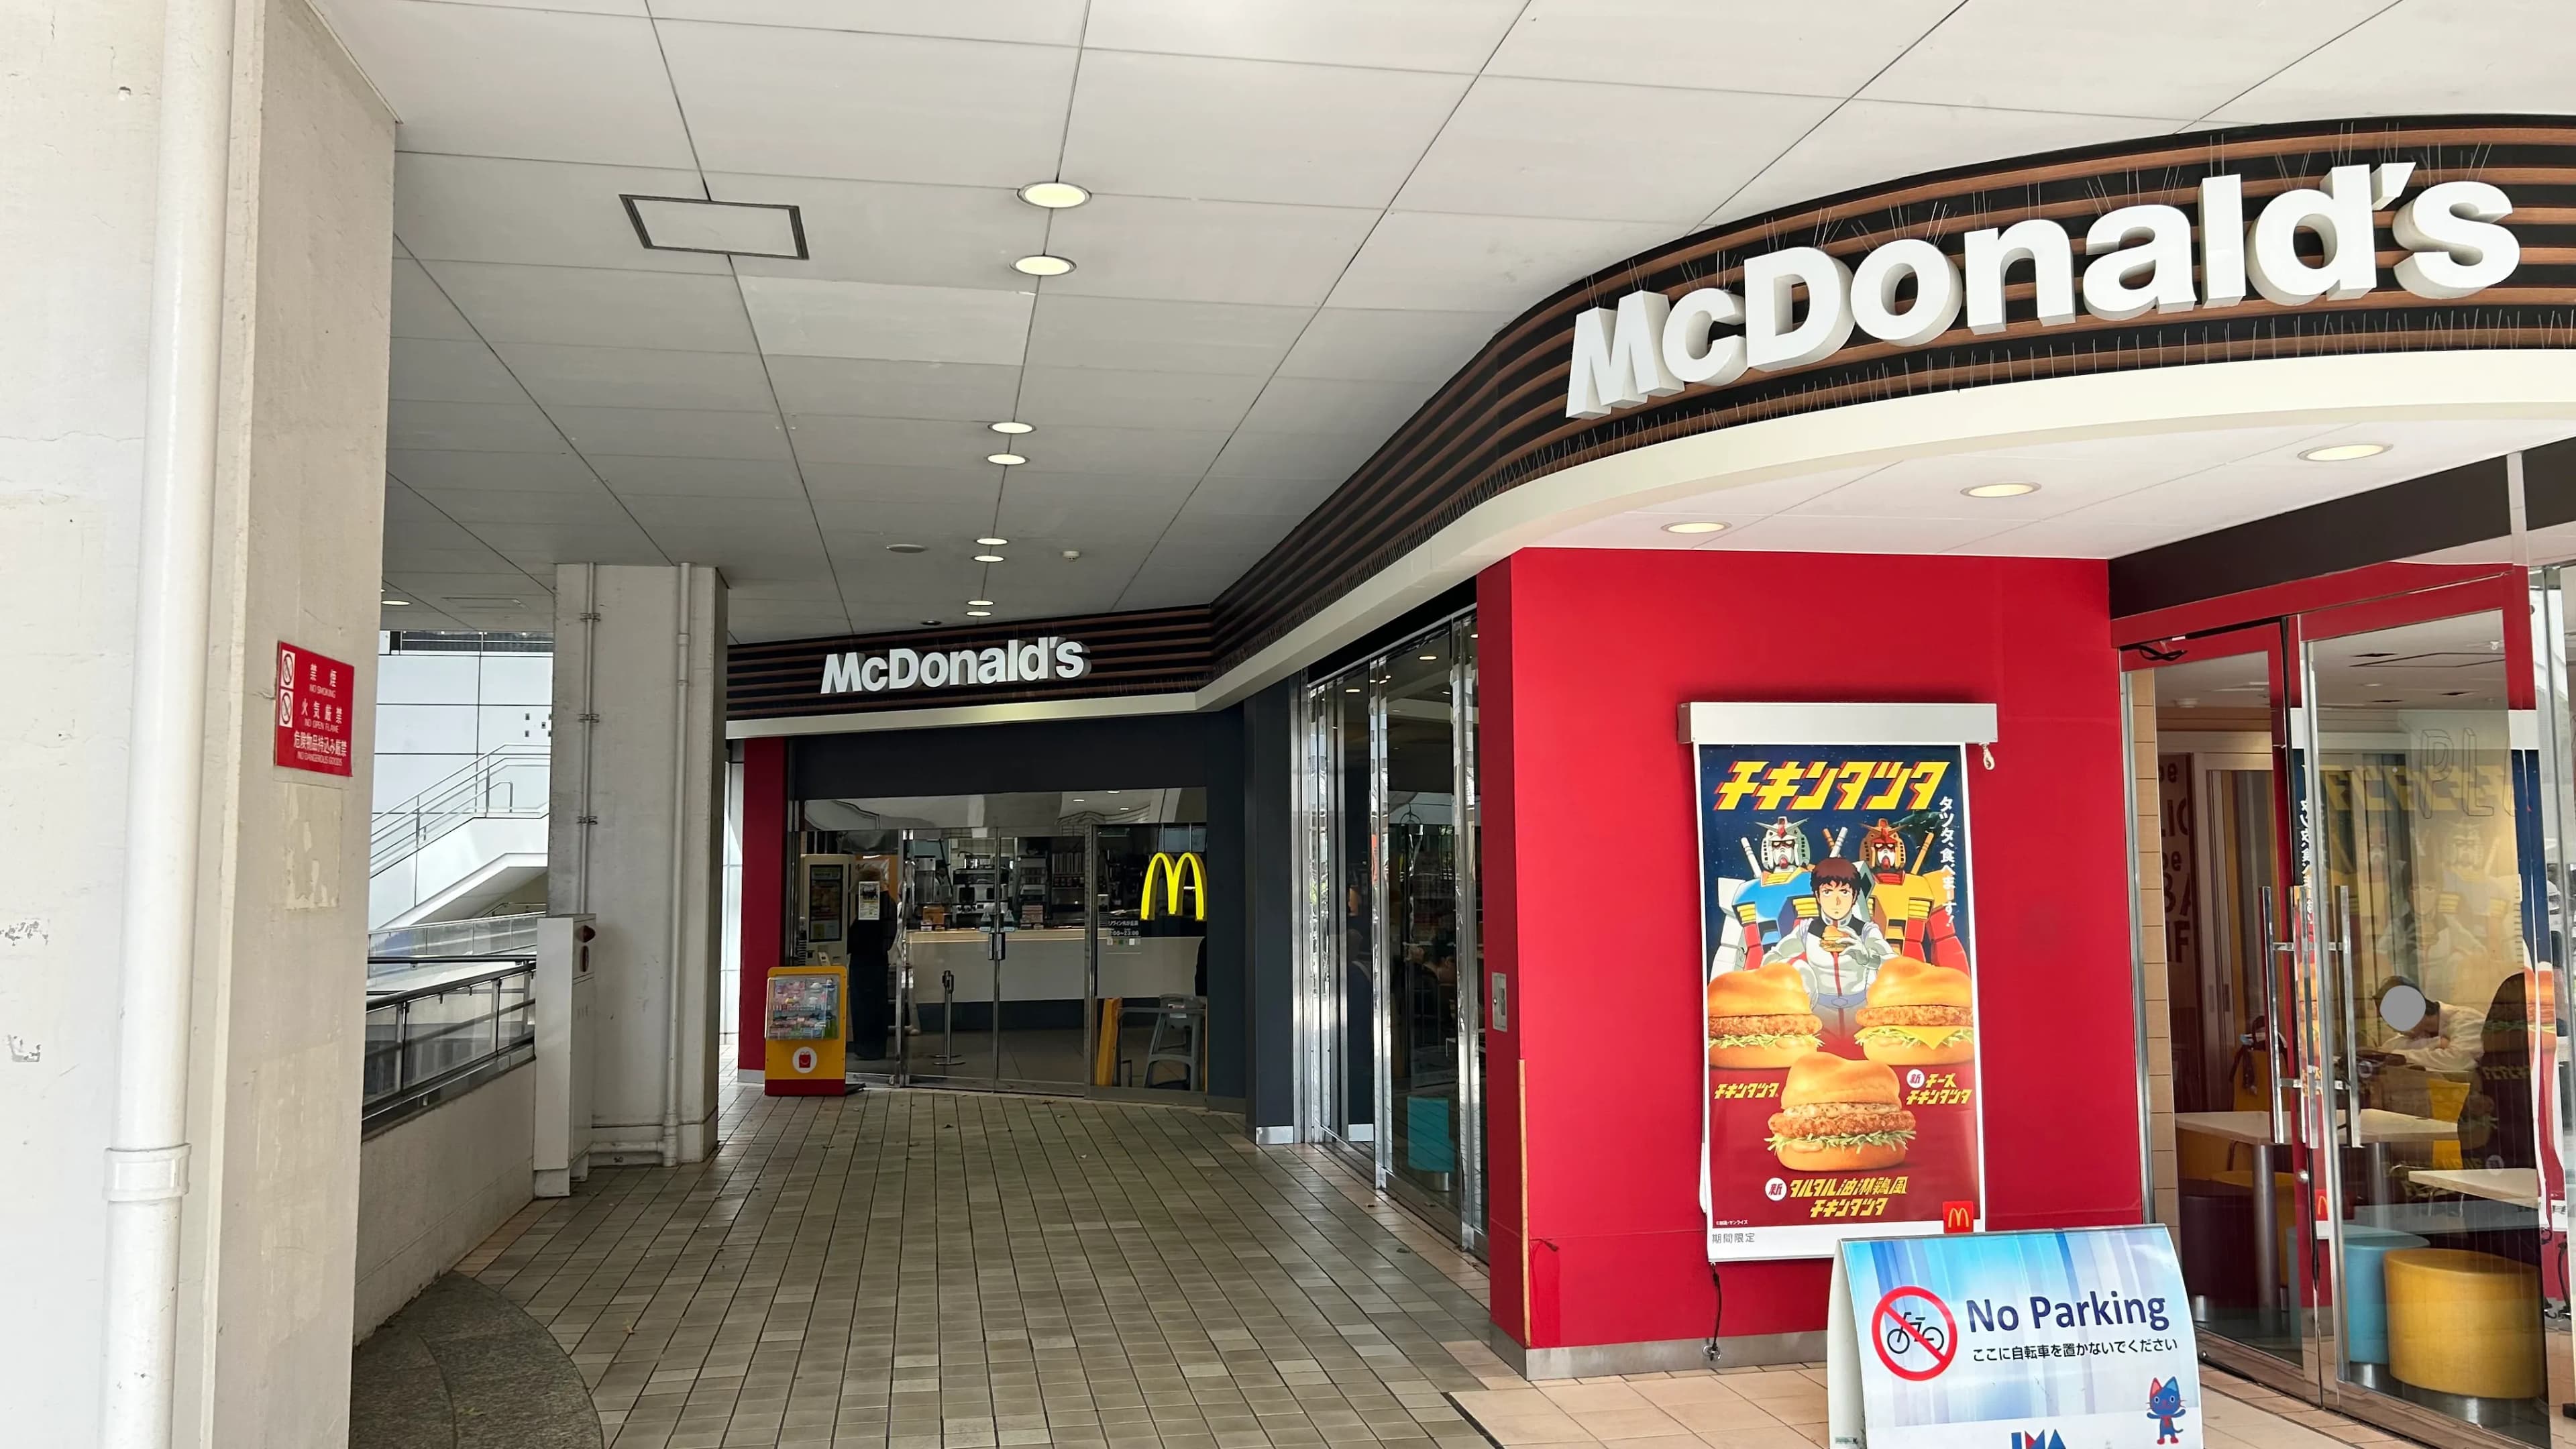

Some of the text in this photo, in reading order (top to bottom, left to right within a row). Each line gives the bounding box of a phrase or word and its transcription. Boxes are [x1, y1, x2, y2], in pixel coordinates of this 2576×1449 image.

[1566, 162, 2522, 419] McDonald's
[820, 636, 1088, 694] McDonald's
[309, 684, 336, 698] NO SMOKING
[301, 698, 343, 724] 火気厳禁
[305, 718, 312, 727] NO
[313, 720, 325, 731] OPEN
[1713, 760, 1951, 810] チキンタツタ
[2420, 727, 2517, 819] PL
[1906, 1089, 1973, 1106] チキンタツタ
[1790, 1176, 1909, 1197] タルタル油淋鶏風
[1810, 1197, 1889, 1218] チキンタツタ
[1712, 1233, 1755, 1244] 期間限定
[1966, 1290, 2169, 1332] No Parking
[1973, 1338, 2178, 1362] ここに自転車を置かないでください
